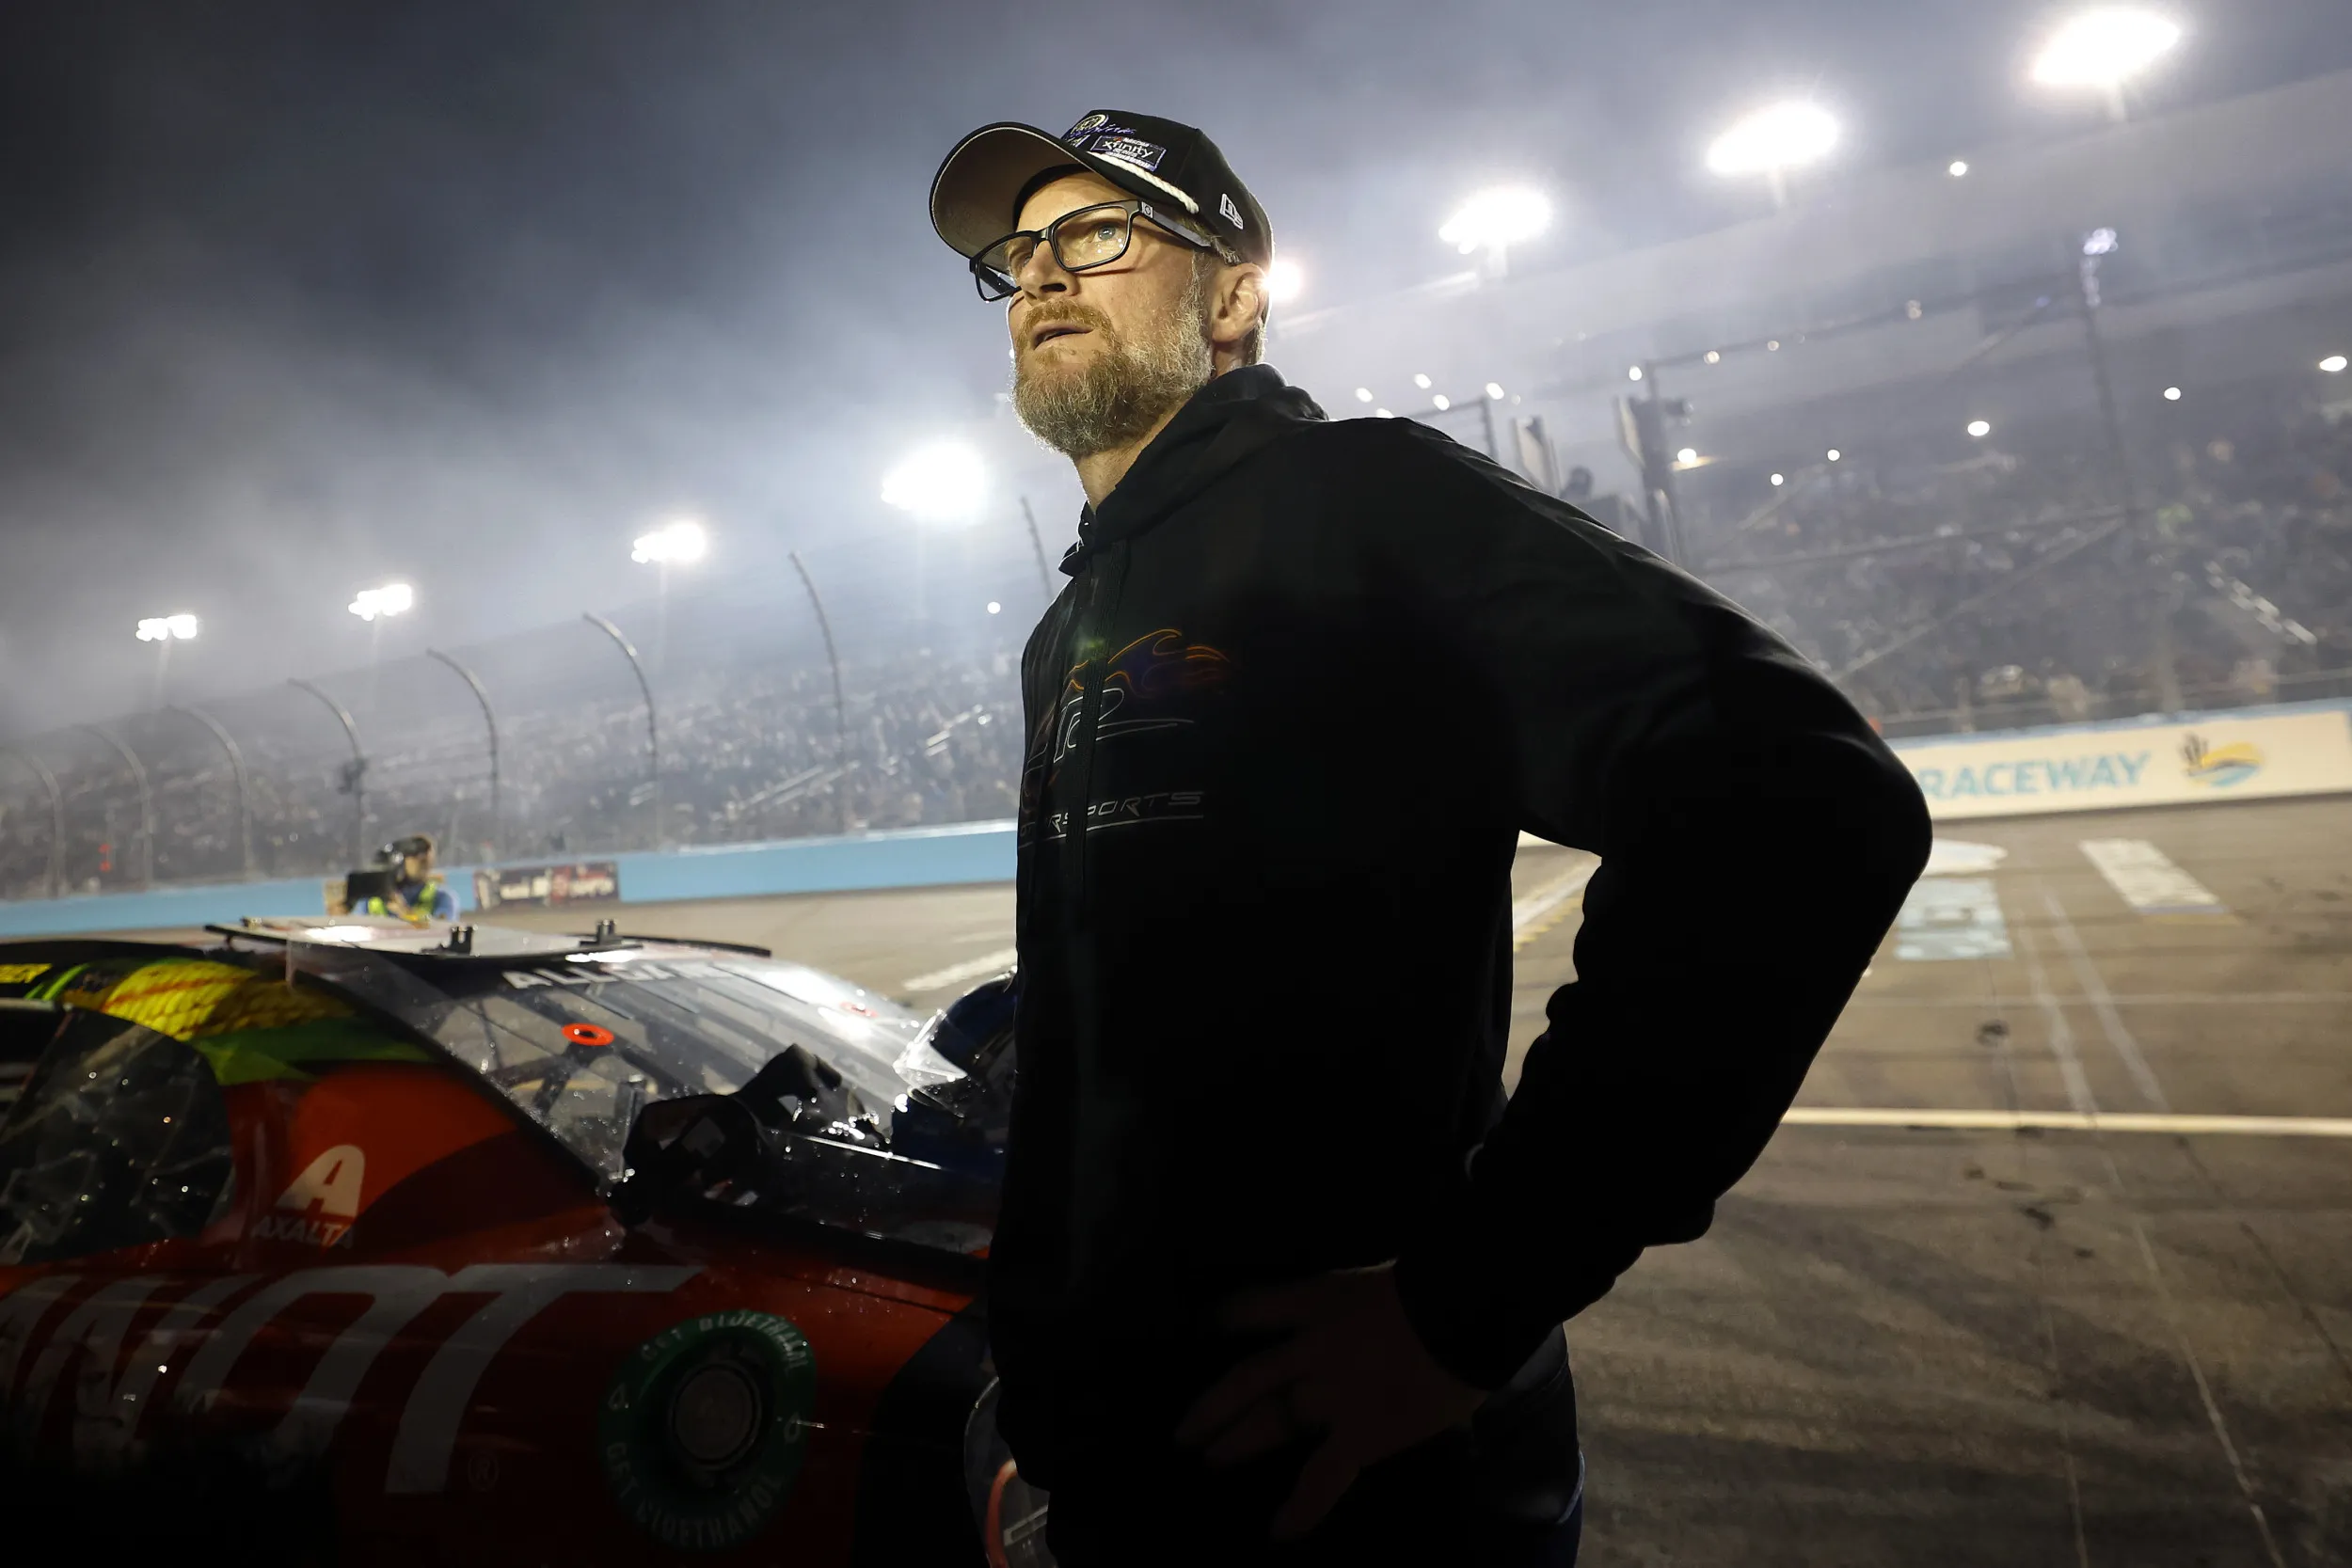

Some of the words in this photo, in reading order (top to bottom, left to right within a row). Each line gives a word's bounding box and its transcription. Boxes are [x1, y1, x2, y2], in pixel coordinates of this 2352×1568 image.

[1102, 140, 1153, 158] xfinity
[1918, 750, 2153, 800] RACEWAY
[274, 1143, 366, 1219] A
[250, 1214, 354, 1249] AXALTA
